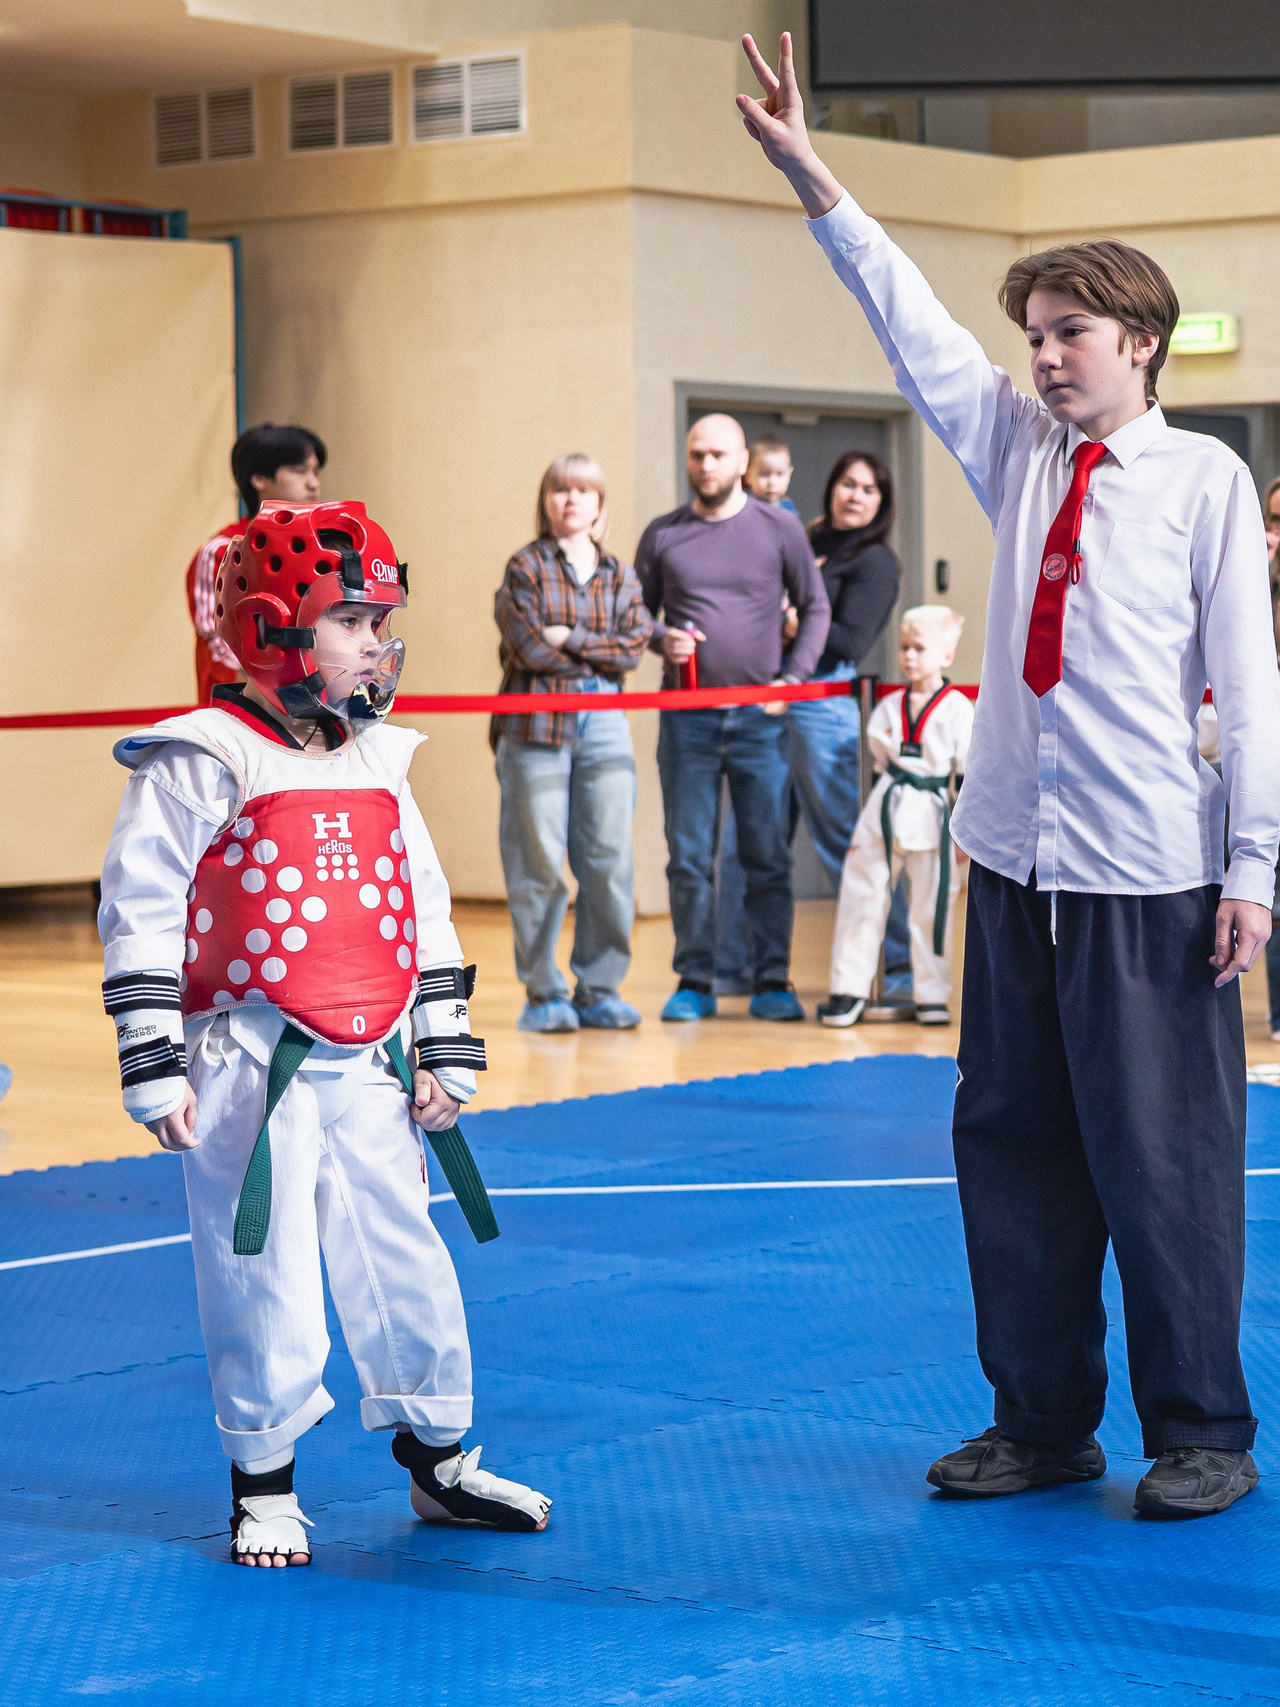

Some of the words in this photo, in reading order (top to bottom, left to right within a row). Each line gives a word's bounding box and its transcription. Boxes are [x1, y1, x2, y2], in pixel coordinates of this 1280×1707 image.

[318, 839, 352, 854] HEROS
[126, 1024, 157, 1035] PANTHER
[352, 1014, 366, 1035] 0
[126, 1030, 157, 1040] ENERGY
